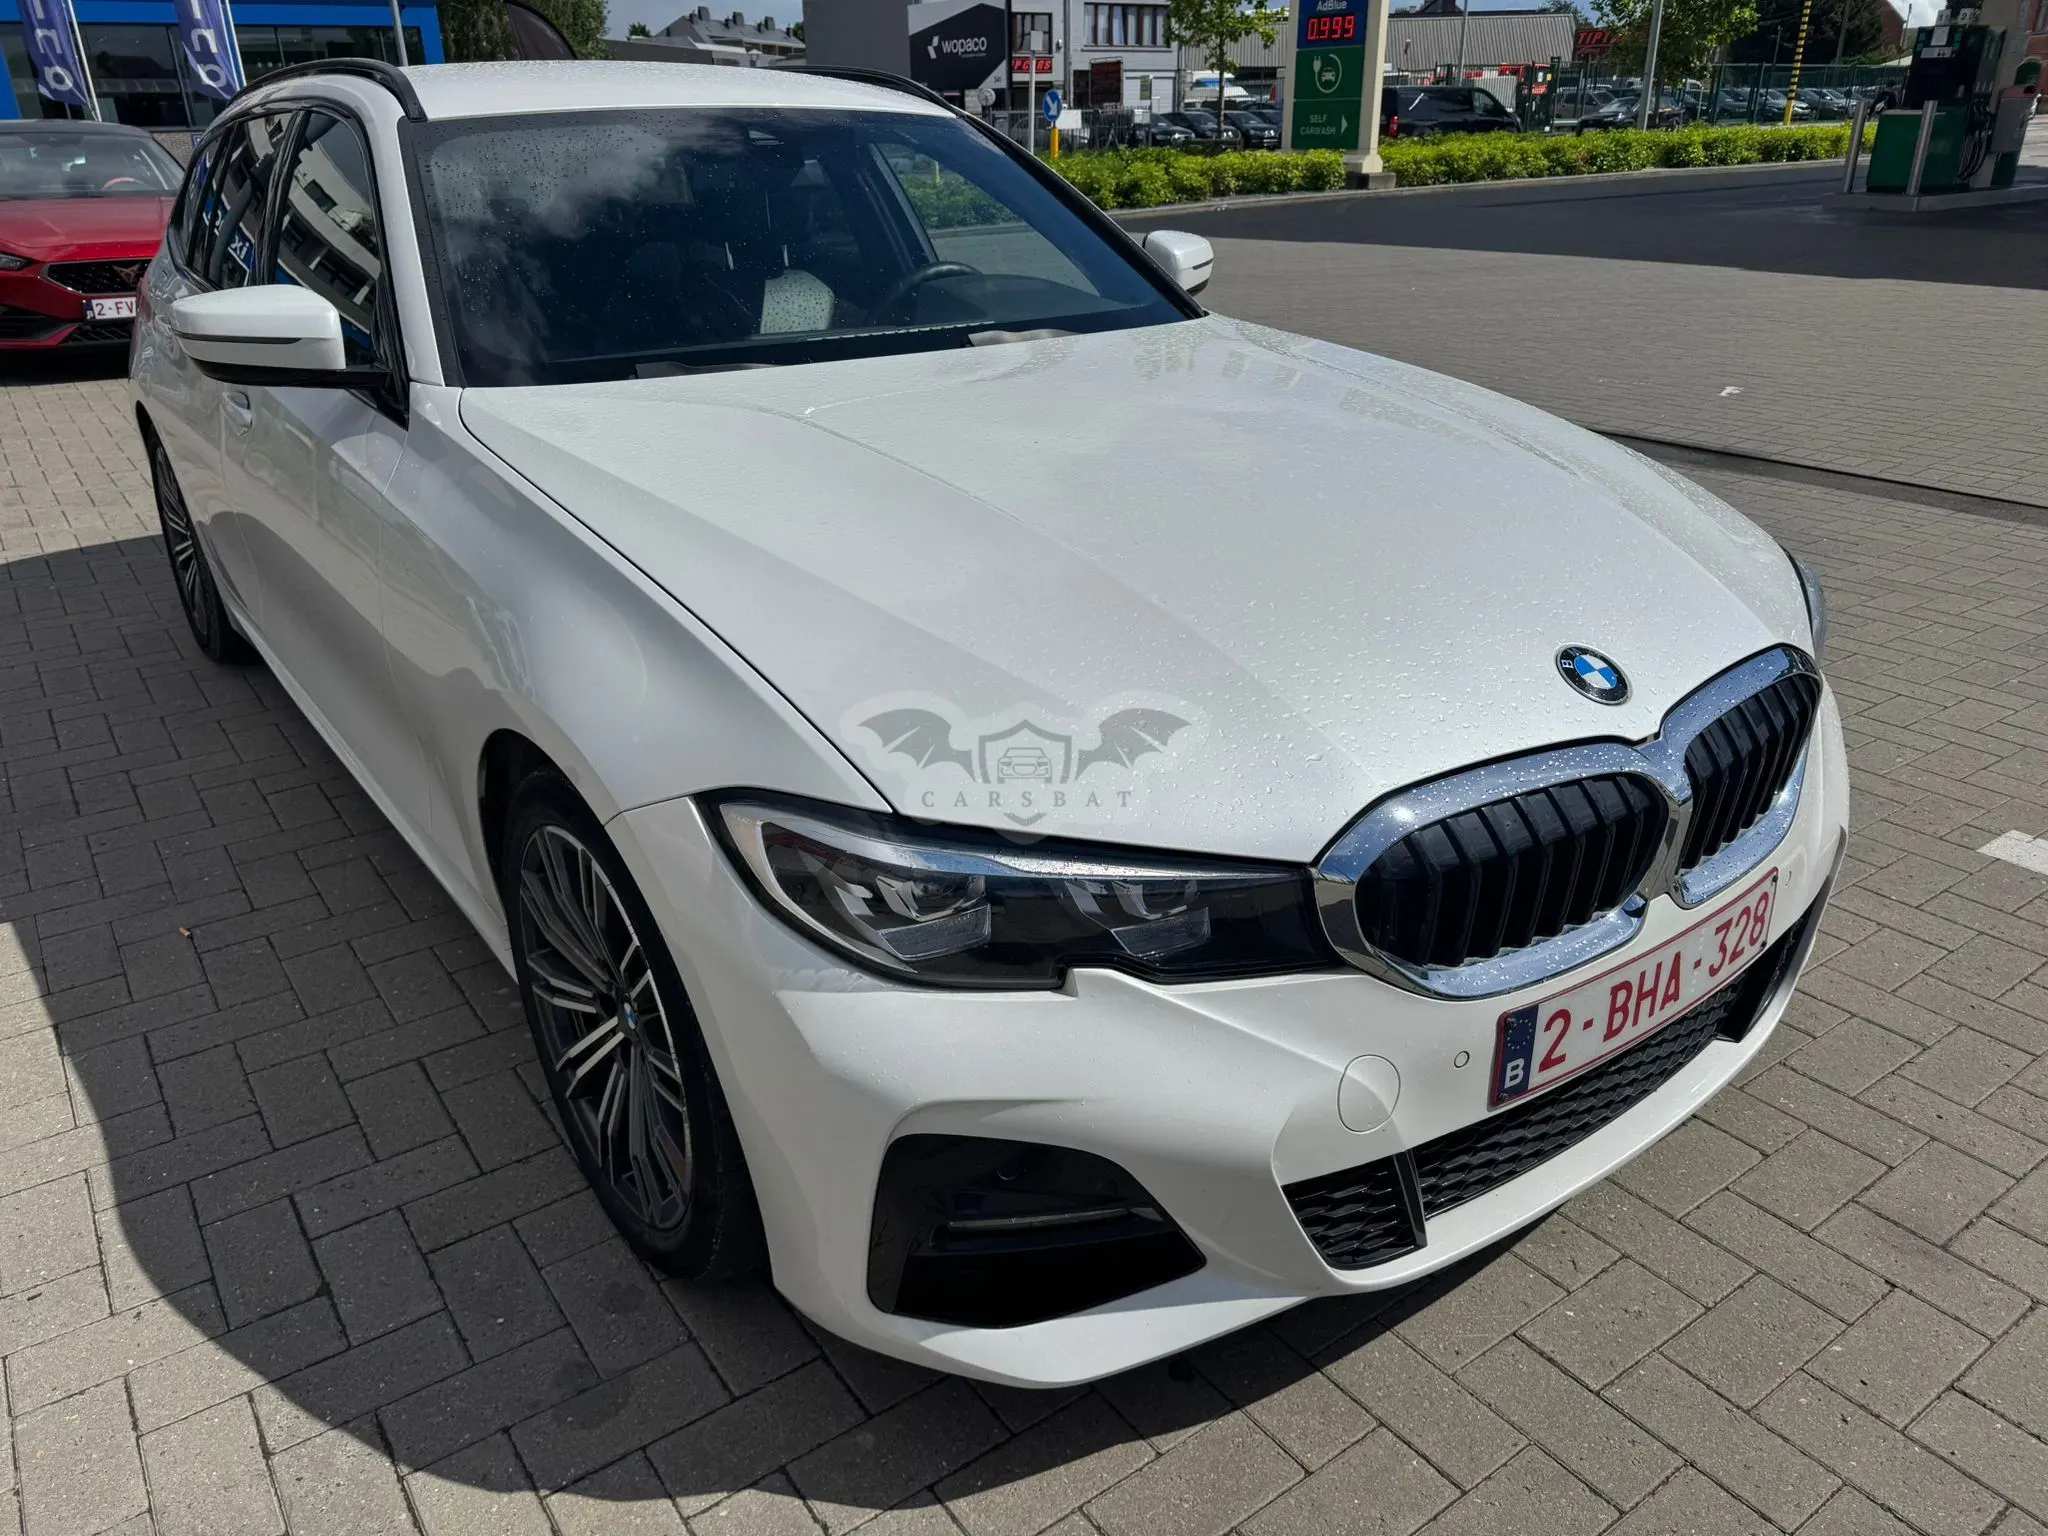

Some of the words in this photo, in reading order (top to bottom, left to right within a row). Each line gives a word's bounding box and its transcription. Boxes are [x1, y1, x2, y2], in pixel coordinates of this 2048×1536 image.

[1316, 0, 1348, 11] AdBlue
[1307, 16, 1355, 40] 0.999
[941, 37, 987, 56] wopaco
[1310, 114, 1328, 123] SELF
[1300, 126, 1336, 136] CARWASH
[1504, 1058, 1525, 1089] B
